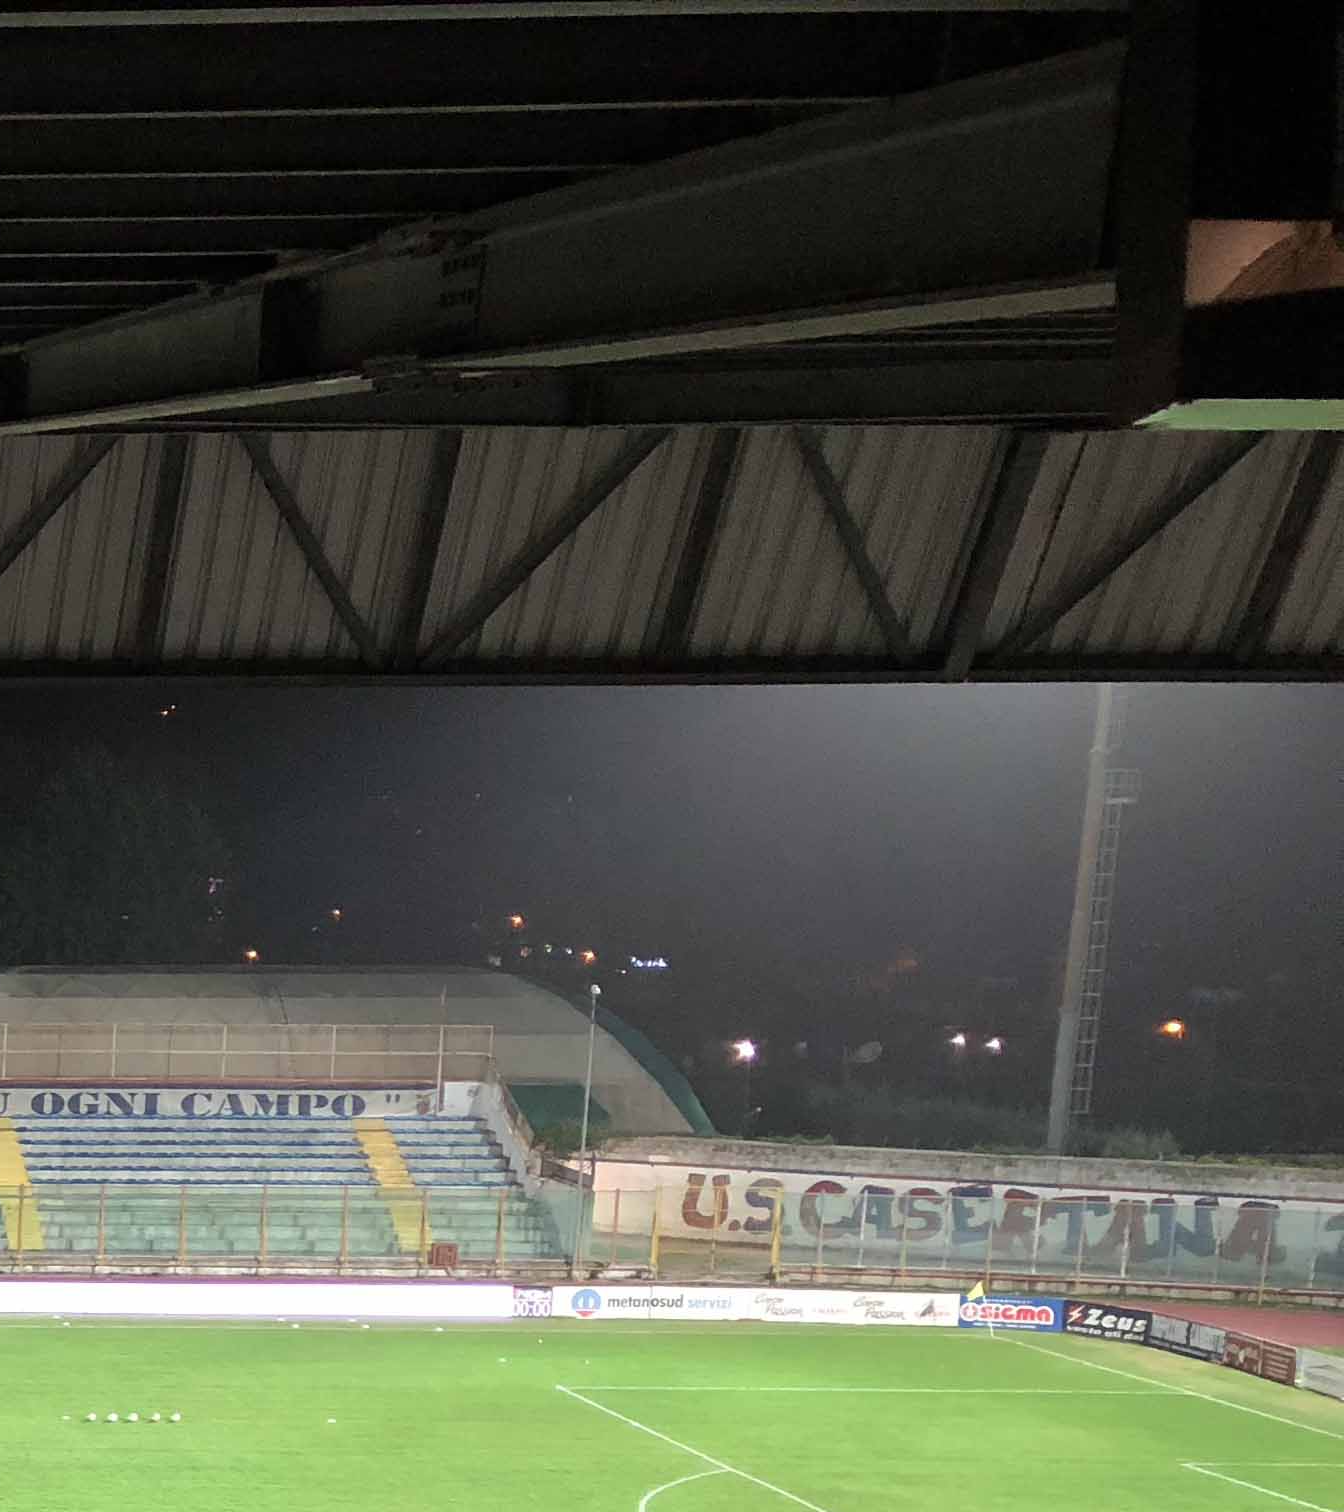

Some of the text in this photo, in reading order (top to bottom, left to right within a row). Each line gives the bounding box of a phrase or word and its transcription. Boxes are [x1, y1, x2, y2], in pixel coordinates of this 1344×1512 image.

[29, 1091, 162, 1117] OGNI
[179, 1091, 367, 1118] CAMPO
[607, 1294, 685, 1309] metanosud
[1083, 1308, 1148, 1333] Zeus
